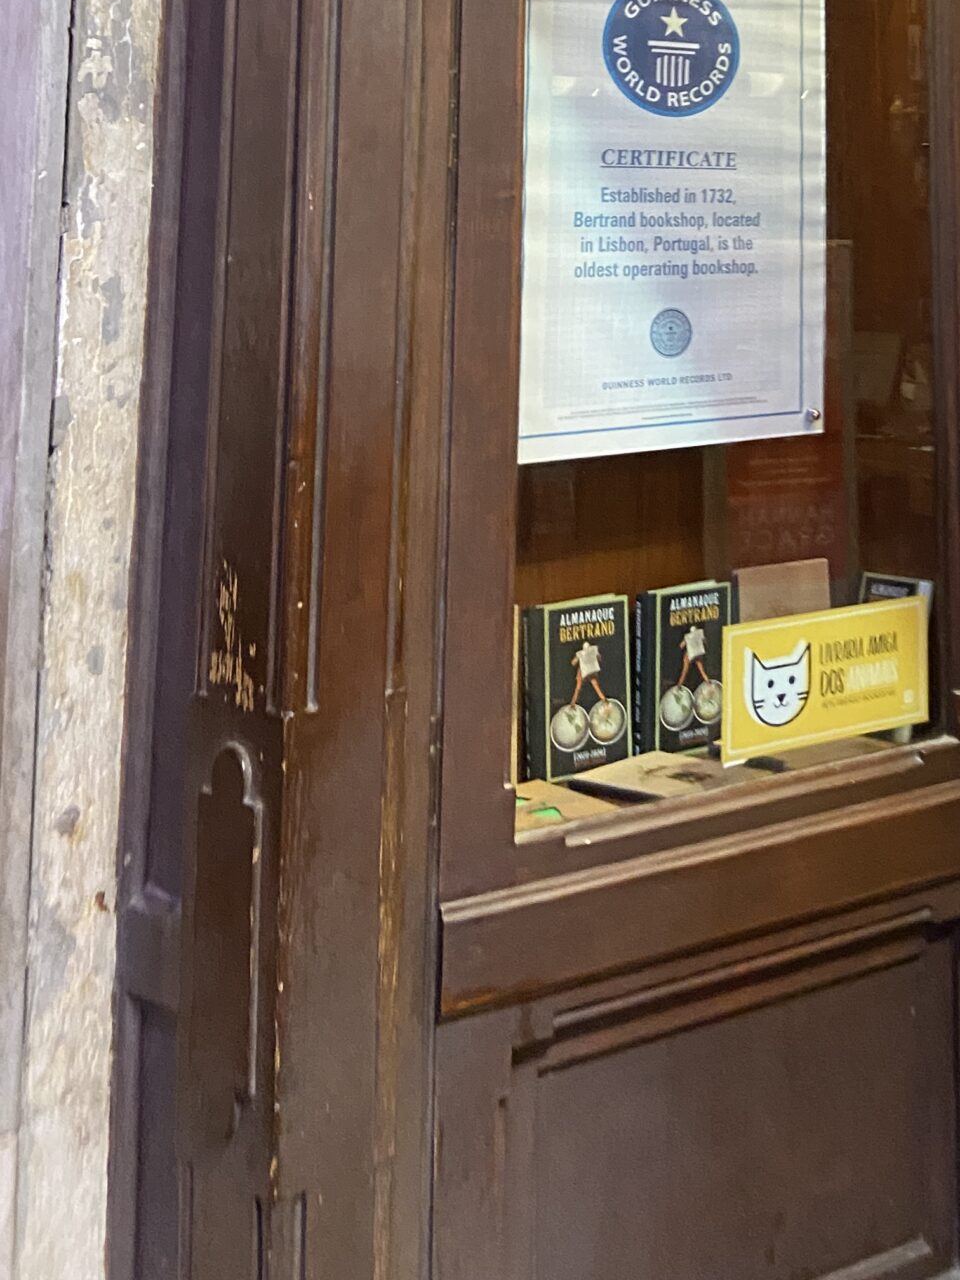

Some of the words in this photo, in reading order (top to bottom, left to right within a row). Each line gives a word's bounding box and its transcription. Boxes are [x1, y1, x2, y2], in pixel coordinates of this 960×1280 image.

[613, 35, 661, 103] WORLD
[667, 42, 732, 107] RECORDS
[600, 149, 737, 167] CERTIFICATE
[601, 187, 680, 203] Established
[684, 188, 696, 203] in
[574, 211, 636, 227] Bertrand
[640, 212, 708, 231] bookshop,
[712, 212, 761, 228] located
[581, 236, 593, 252] in
[598, 236, 648, 253] Lisbon,
[653, 236, 714, 254] Portugal,
[718, 236, 728, 250] is
[732, 235, 753, 251] the
[574, 262, 618, 278] oldest
[622, 260, 688, 280] operating
[692, 259, 759, 277] bookshop.
[602, 378, 645, 390] GUINNESS
[648, 375, 677, 387] WORLD
[679, 373, 715, 385] RECORDS
[670, 592, 720, 611] ALMANAQUE
[560, 607, 615, 627] ALMANAQUE
[559, 621, 616, 644] BERTRAND
[820, 666, 845, 698] DOS
